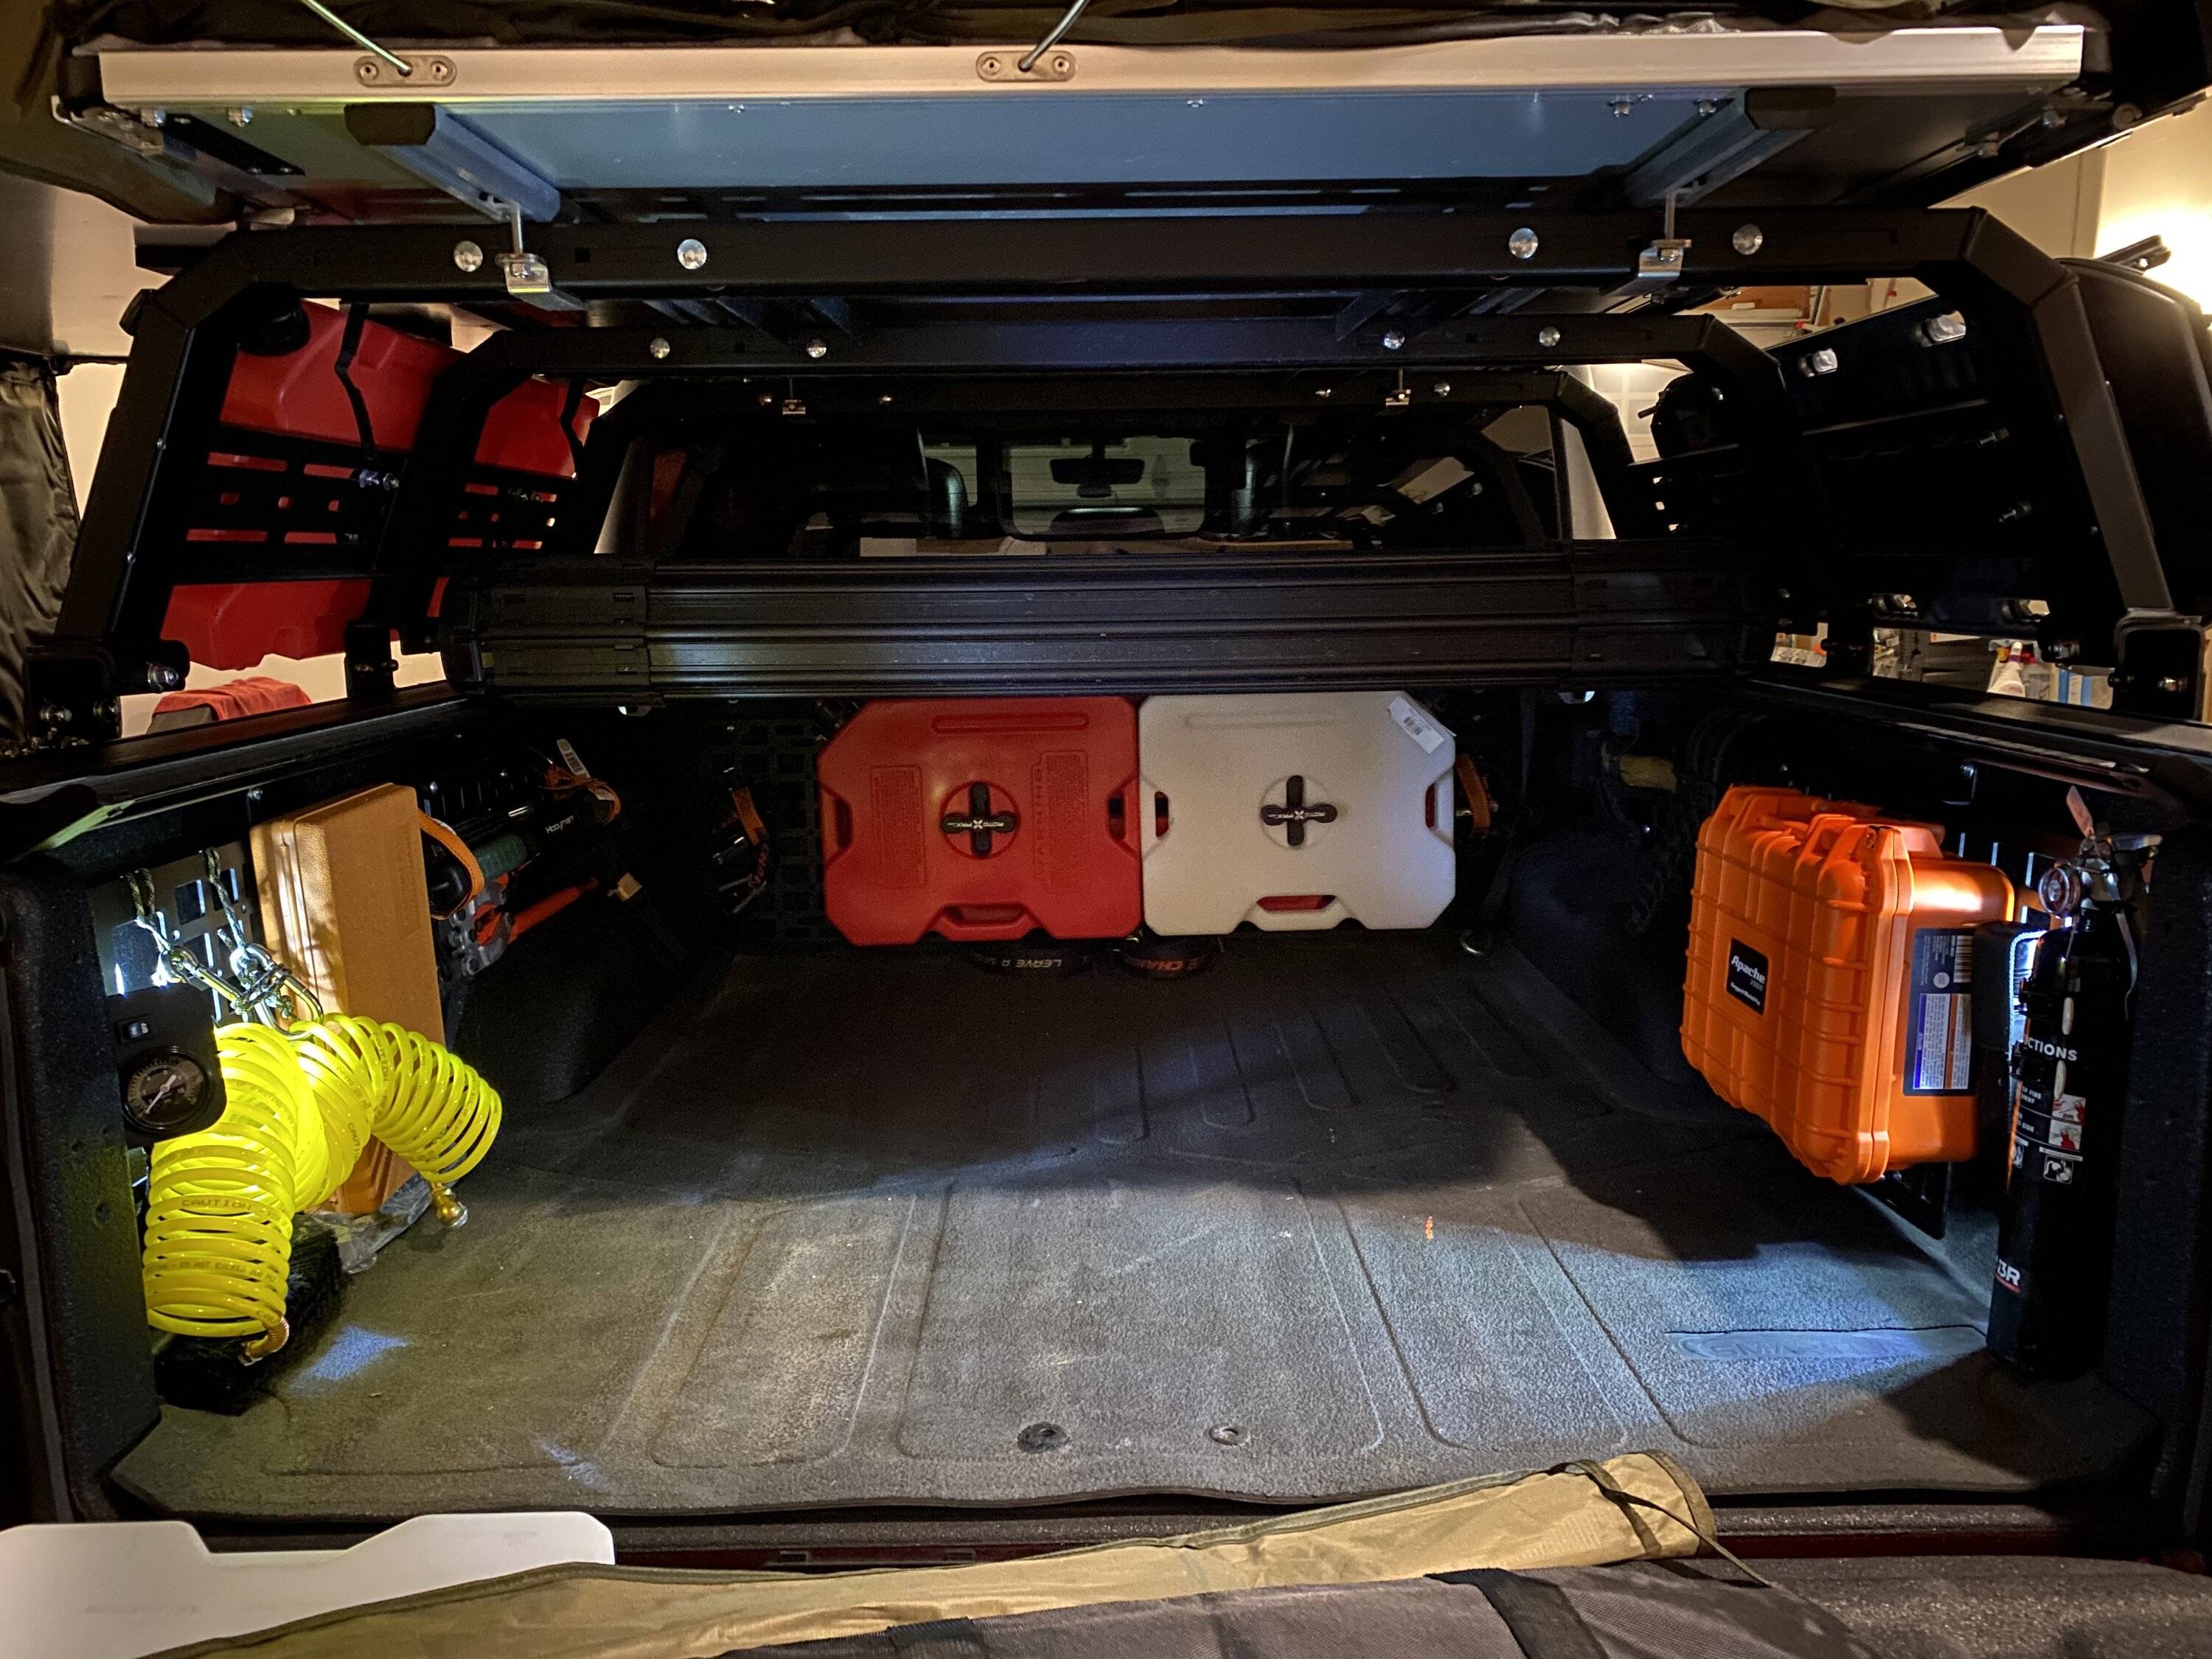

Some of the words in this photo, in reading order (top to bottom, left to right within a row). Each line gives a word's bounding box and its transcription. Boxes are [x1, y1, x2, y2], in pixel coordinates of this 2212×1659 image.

[1015, 959, 1062, 967] LEAVE
[1731, 955, 1765, 984] Apache
[2024, 1037, 2078, 1061] CTIONS
[181, 1199, 252, 1210] CAUTION
[1997, 1259, 2020, 1286] 3R
